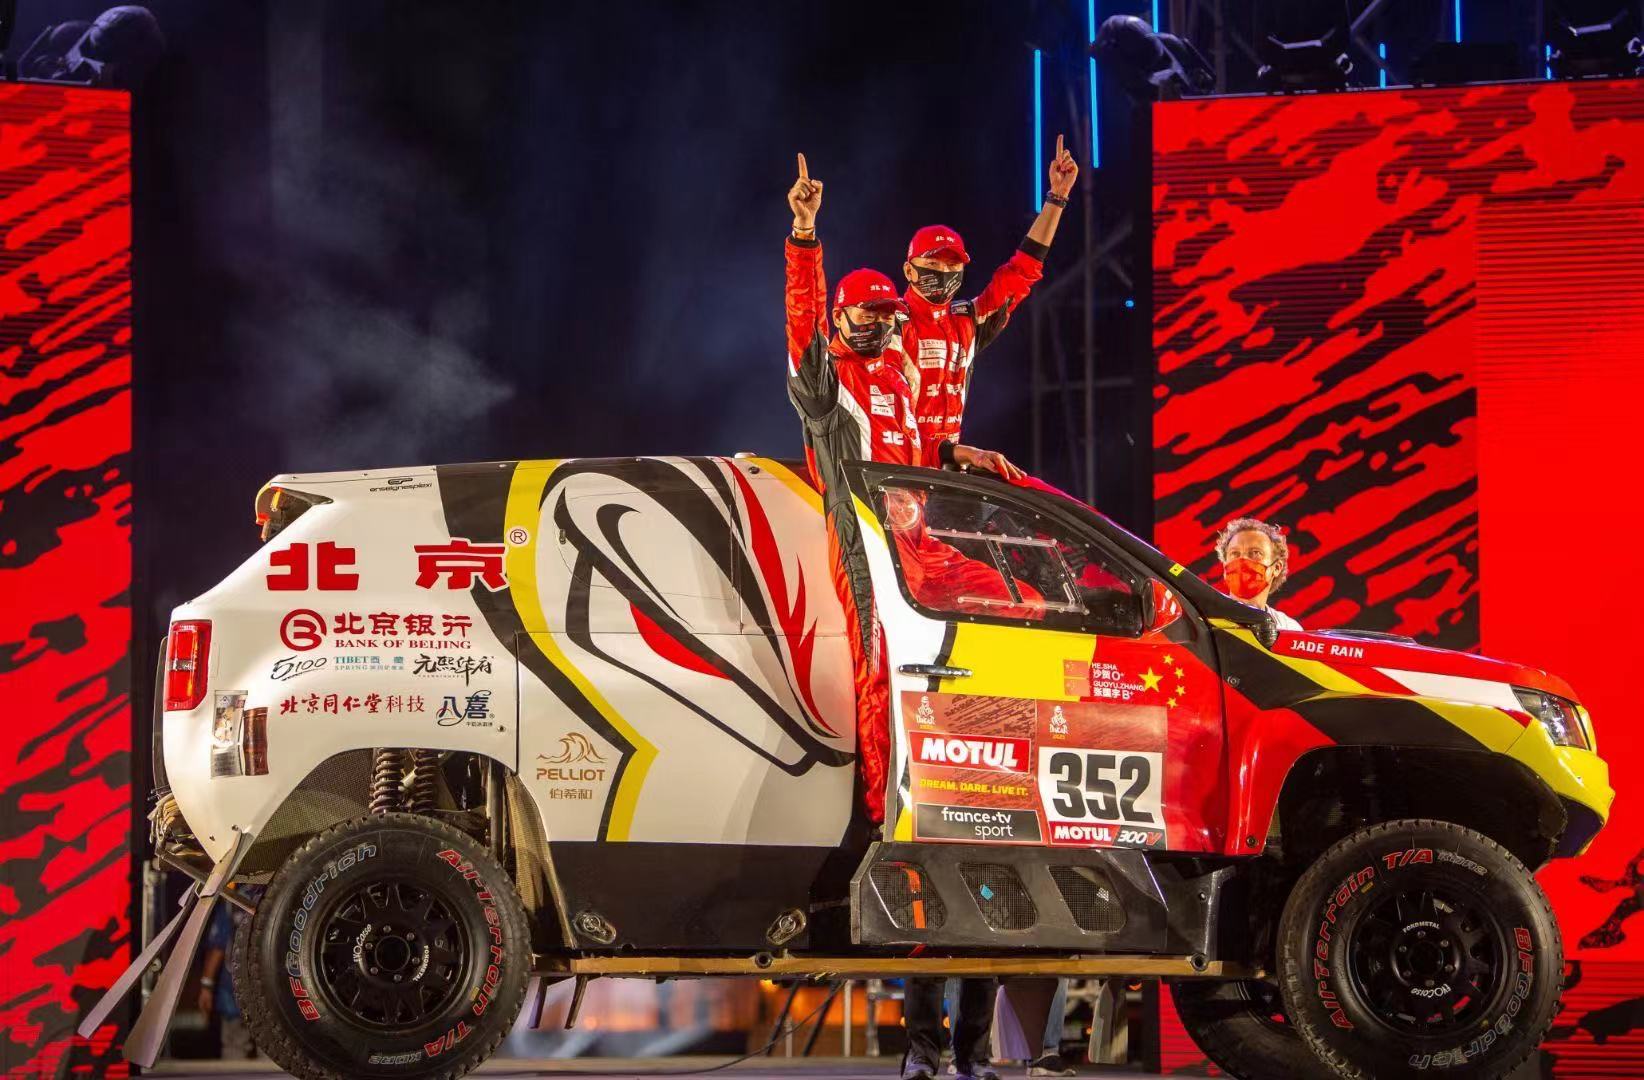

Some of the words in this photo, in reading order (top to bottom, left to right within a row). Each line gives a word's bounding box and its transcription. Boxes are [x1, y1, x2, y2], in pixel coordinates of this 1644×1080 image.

[333, 611, 473, 638] 北京银行
[335, 640, 378, 648] BANK
[383, 640, 404, 648] OF
[409, 640, 472, 650] BEIJING
[1290, 640, 1325, 654] JADE
[1330, 644, 1364, 659] RAIN
[271, 655, 327, 680] 5100
[334, 655, 369, 664] TIBET
[280, 693, 425, 715] 北京同仁堂科技
[439, 695, 490, 719] 八喜
[920, 737, 1018, 768] MOTUL
[536, 768, 605, 781] PELLIOT
[550, 788, 592, 800] 伯希和
[920, 779, 958, 791] DREAM.
[960, 782, 990, 793] DARE.
[992, 786, 1014, 795] LIVE
[1016, 787, 1029, 796] IT.
[1049, 752, 1155, 823] 352
[975, 825, 1013, 840] sport
[1054, 826, 1111, 841] MOTUL
[1117, 830, 1162, 846] 300V
